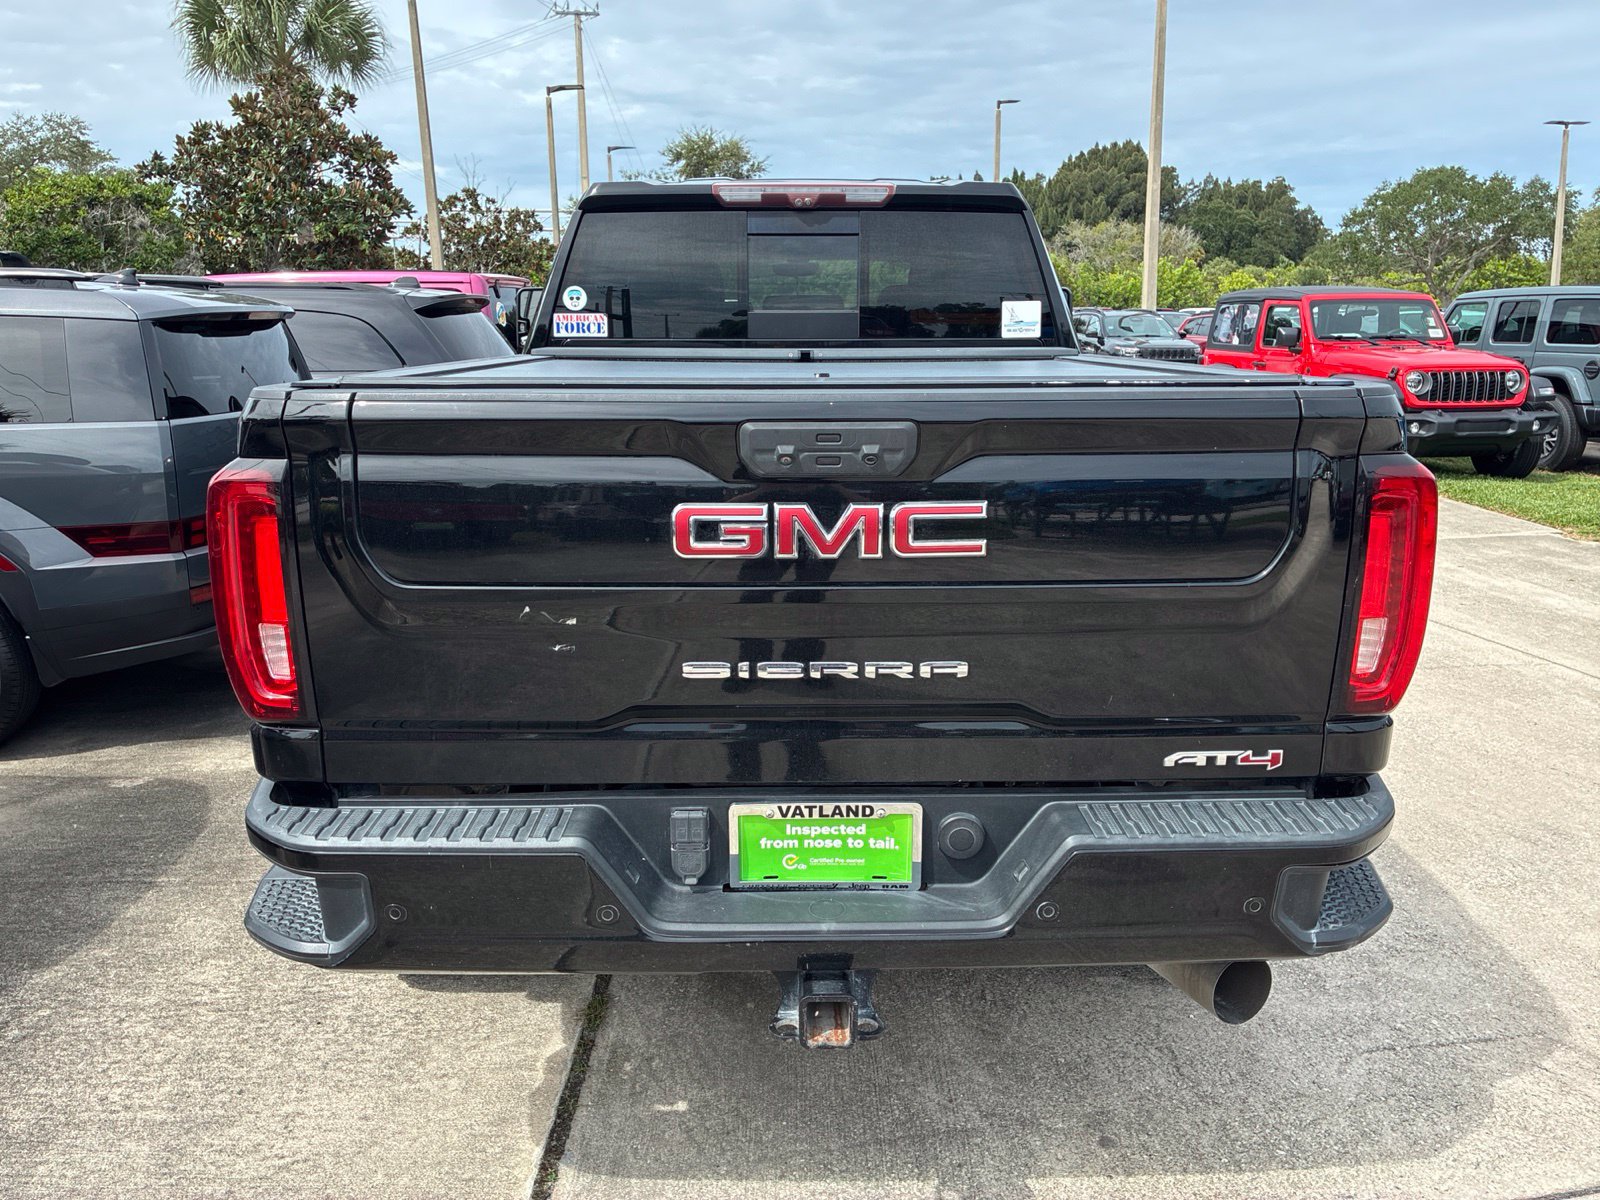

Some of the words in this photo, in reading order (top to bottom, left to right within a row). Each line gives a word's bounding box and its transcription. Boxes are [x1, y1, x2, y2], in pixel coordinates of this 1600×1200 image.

[555, 314, 606, 322] AMERICAN
[555, 322, 606, 334] FORCE
[671, 500, 988, 559] GMC
[682, 661, 969, 679] SIERRA
[1163, 749, 1284, 771] AT4
[777, 804, 875, 819] VATLAND
[785, 823, 867, 838] Inspected
[760, 837, 799, 849] from
[803, 838, 843, 848] nose
[846, 837, 865, 848] to
[868, 836, 900, 850] tail.
